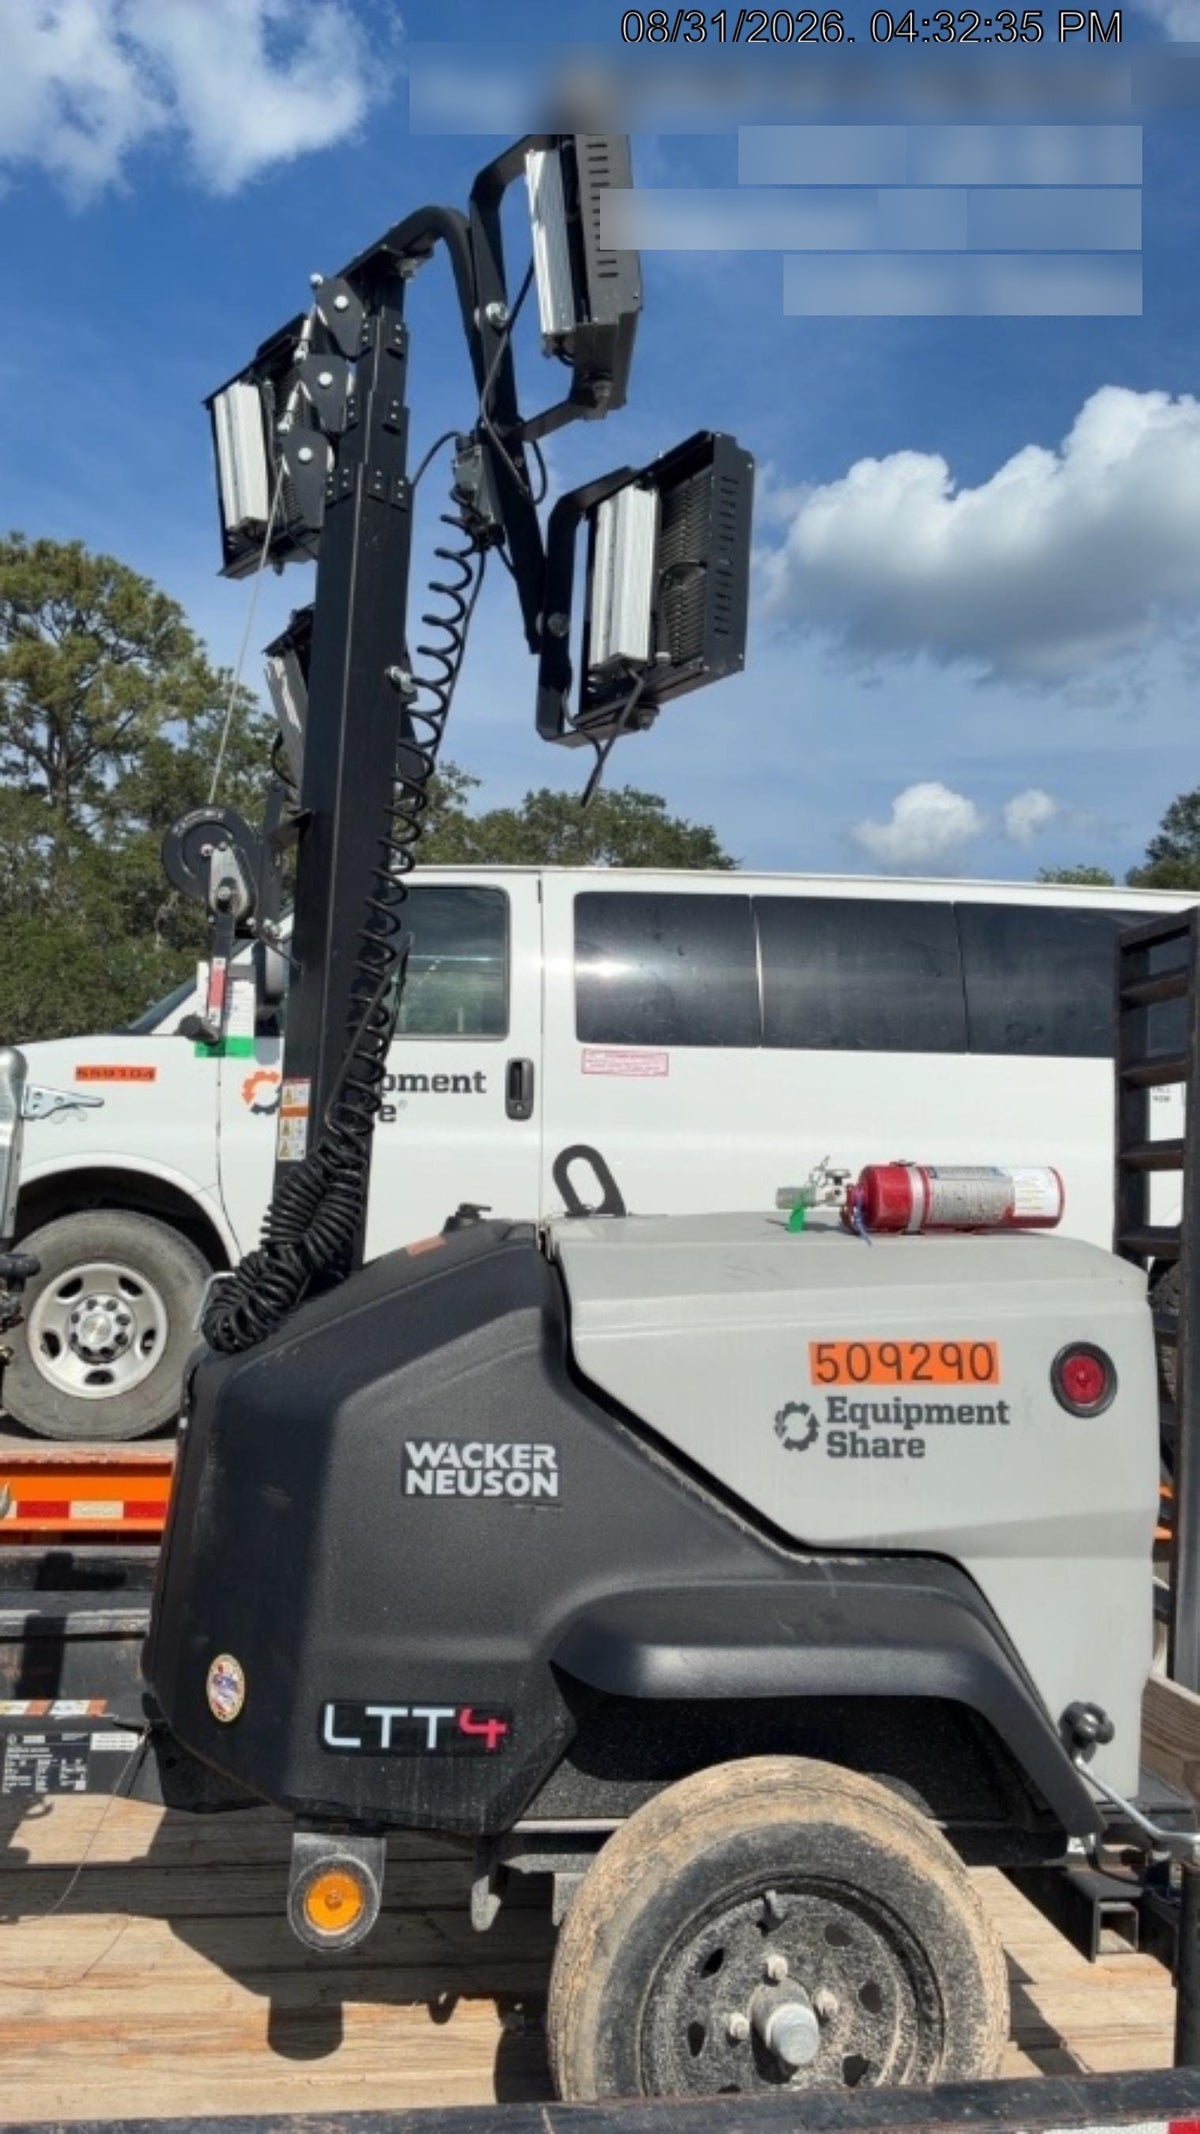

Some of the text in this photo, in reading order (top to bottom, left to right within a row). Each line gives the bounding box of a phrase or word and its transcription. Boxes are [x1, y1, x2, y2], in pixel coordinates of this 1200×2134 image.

[382, 1071, 486, 1098] pment
[816, 1342, 995, 1382] 509290
[826, 1396, 1011, 1430] Equipment
[405, 1441, 558, 1469] WACKER
[826, 1431, 926, 1458] Share
[405, 1469, 559, 1497] NEUSON
[324, 1704, 507, 1749] LTT4
